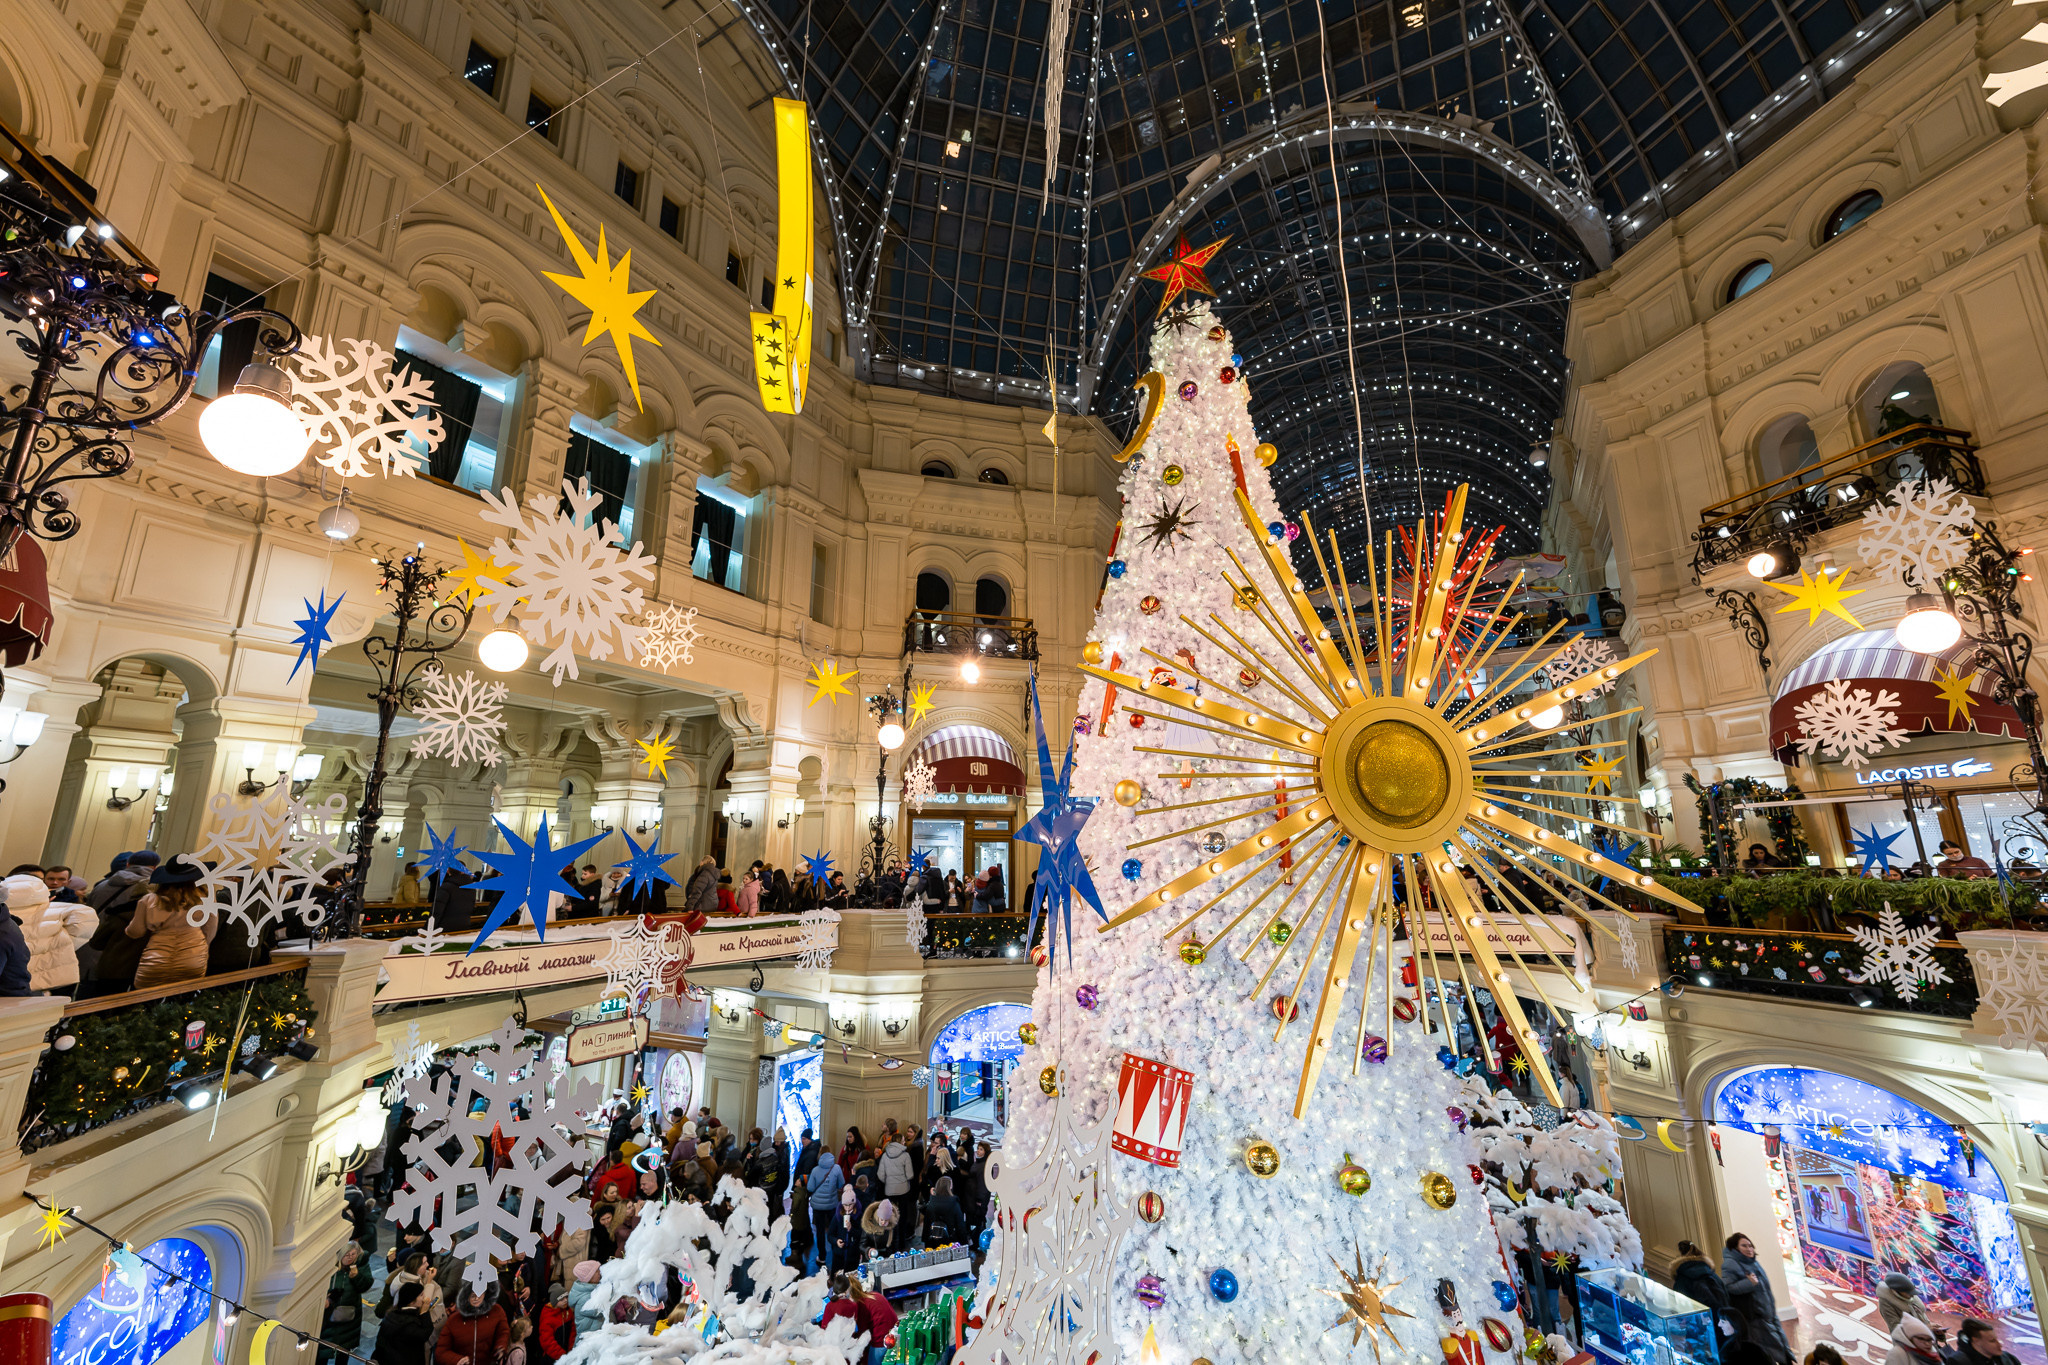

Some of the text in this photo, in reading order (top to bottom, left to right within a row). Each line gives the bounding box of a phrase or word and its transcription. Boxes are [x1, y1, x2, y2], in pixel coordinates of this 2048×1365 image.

[1855, 764, 1951, 785] LACOSTE
[965, 794, 1008, 804] BLAHNIK
[445, 956, 530, 980] Главный
[538, 954, 596, 970] магазин
[719, 942, 736, 952] на
[739, 934, 783, 953] Красной
[582, 1038, 594, 1047] НА
[972, 1030, 1021, 1043] ARTICO
[1779, 1101, 1900, 1144] ARTICOLI
[64, 1296, 157, 1365] TICOLI
